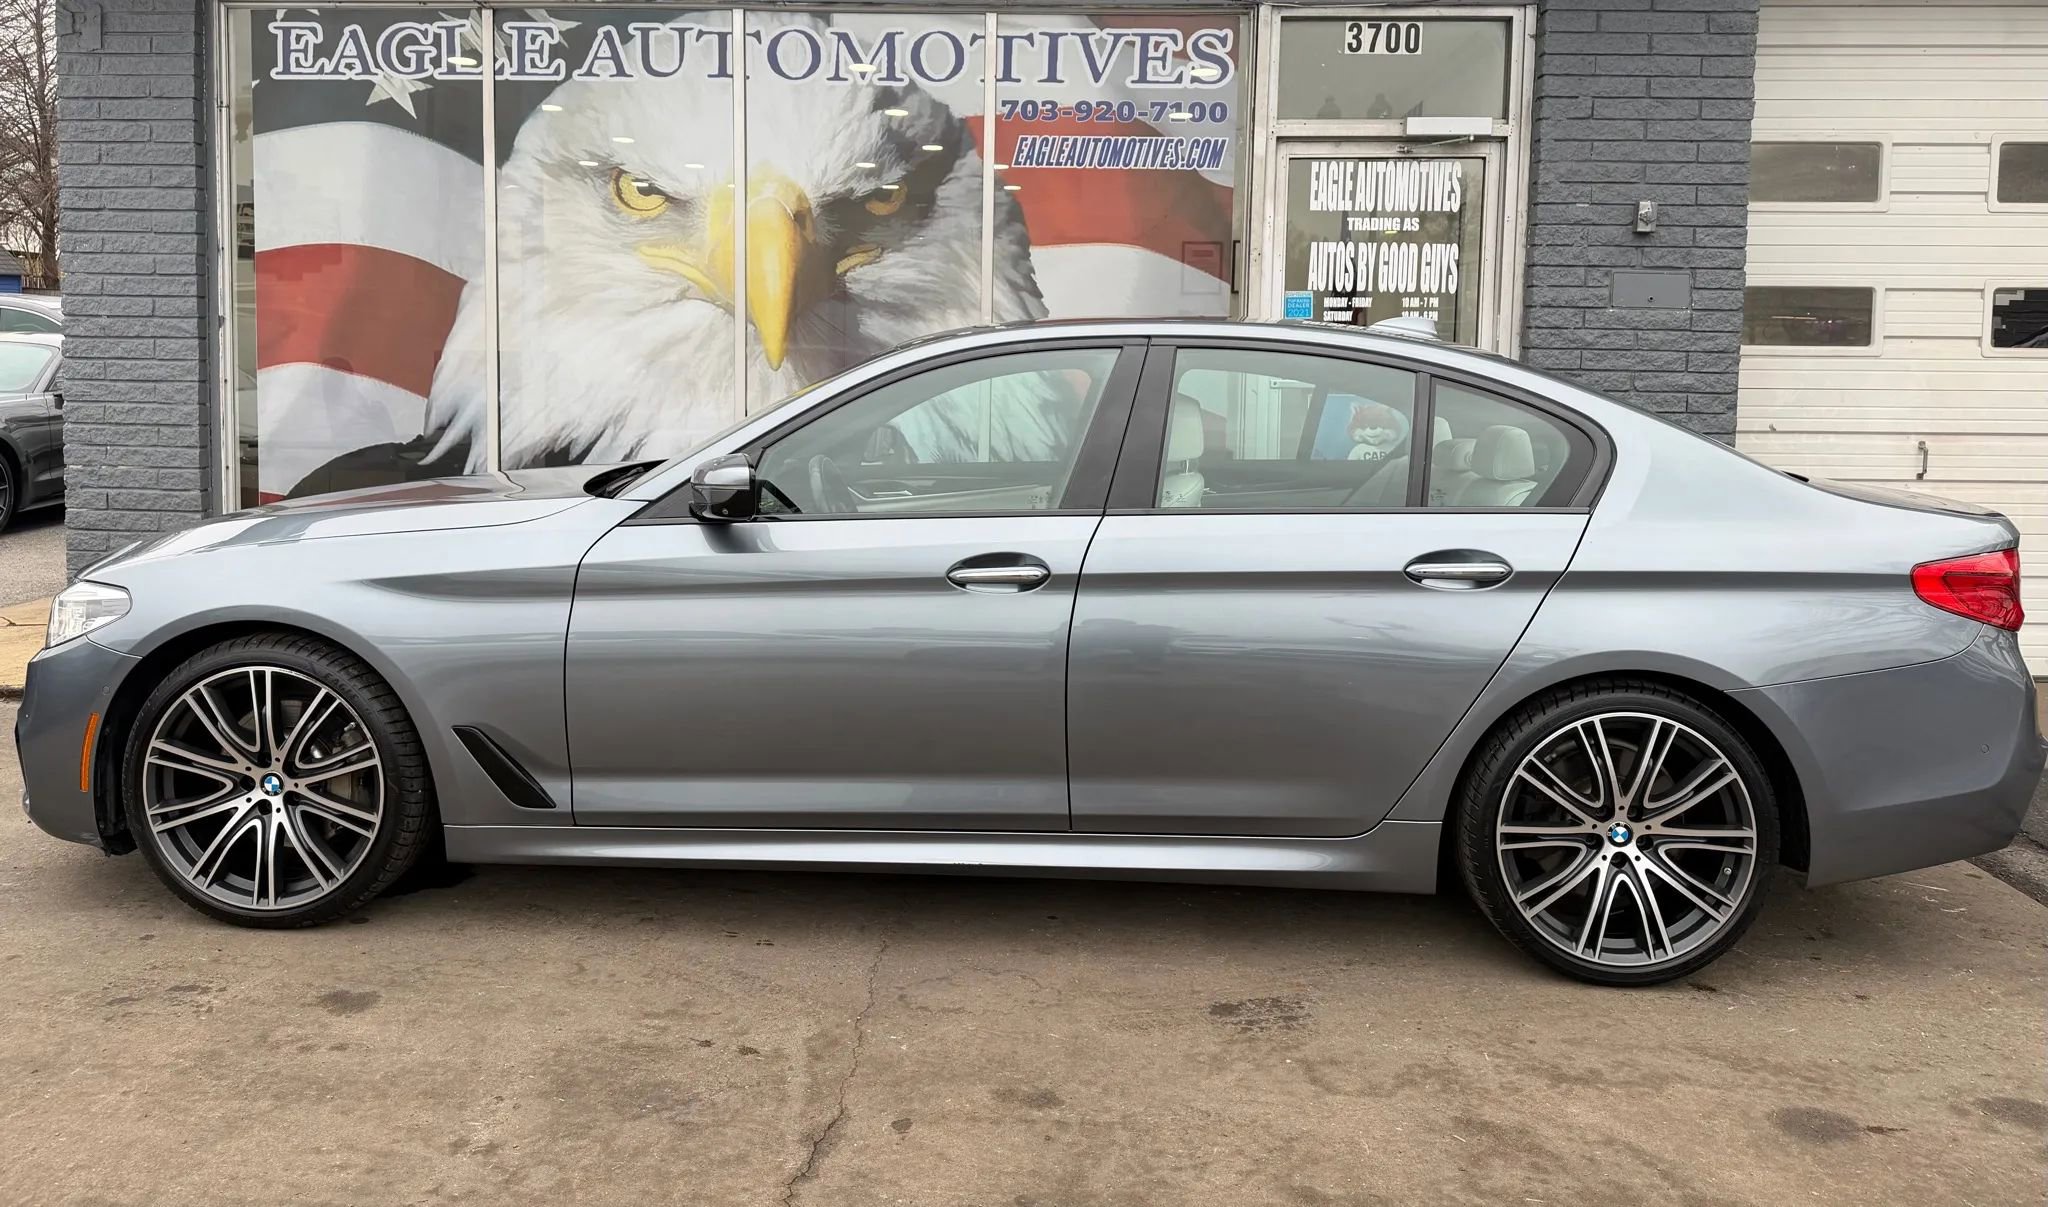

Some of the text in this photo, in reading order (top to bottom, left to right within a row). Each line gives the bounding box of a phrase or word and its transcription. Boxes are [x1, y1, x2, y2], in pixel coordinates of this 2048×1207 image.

[1347, 22, 1421, 53] 3700
[269, 22, 1235, 88] EAGLE AUTOMOTIVES
[1001, 99, 1228, 123] 703-920-7100
[1013, 135, 1229, 170] EAGLEAUTOMOTIVES.COM
[1309, 161, 1462, 213] EAGLE AUTOMOTIVES
[1347, 217, 1420, 232] TRADING AS
[1307, 241, 1459, 294] AUTOS BY GOOD GUYS
[1288, 309, 1310, 317] 2021
[1323, 297, 1349, 308] MONDAY
[1352, 297, 1374, 308] FRIDAY
[1410, 297, 1420, 308] AM
[1429, 297, 1439, 308] PM
[1323, 311, 1353, 322] SATURDAY
